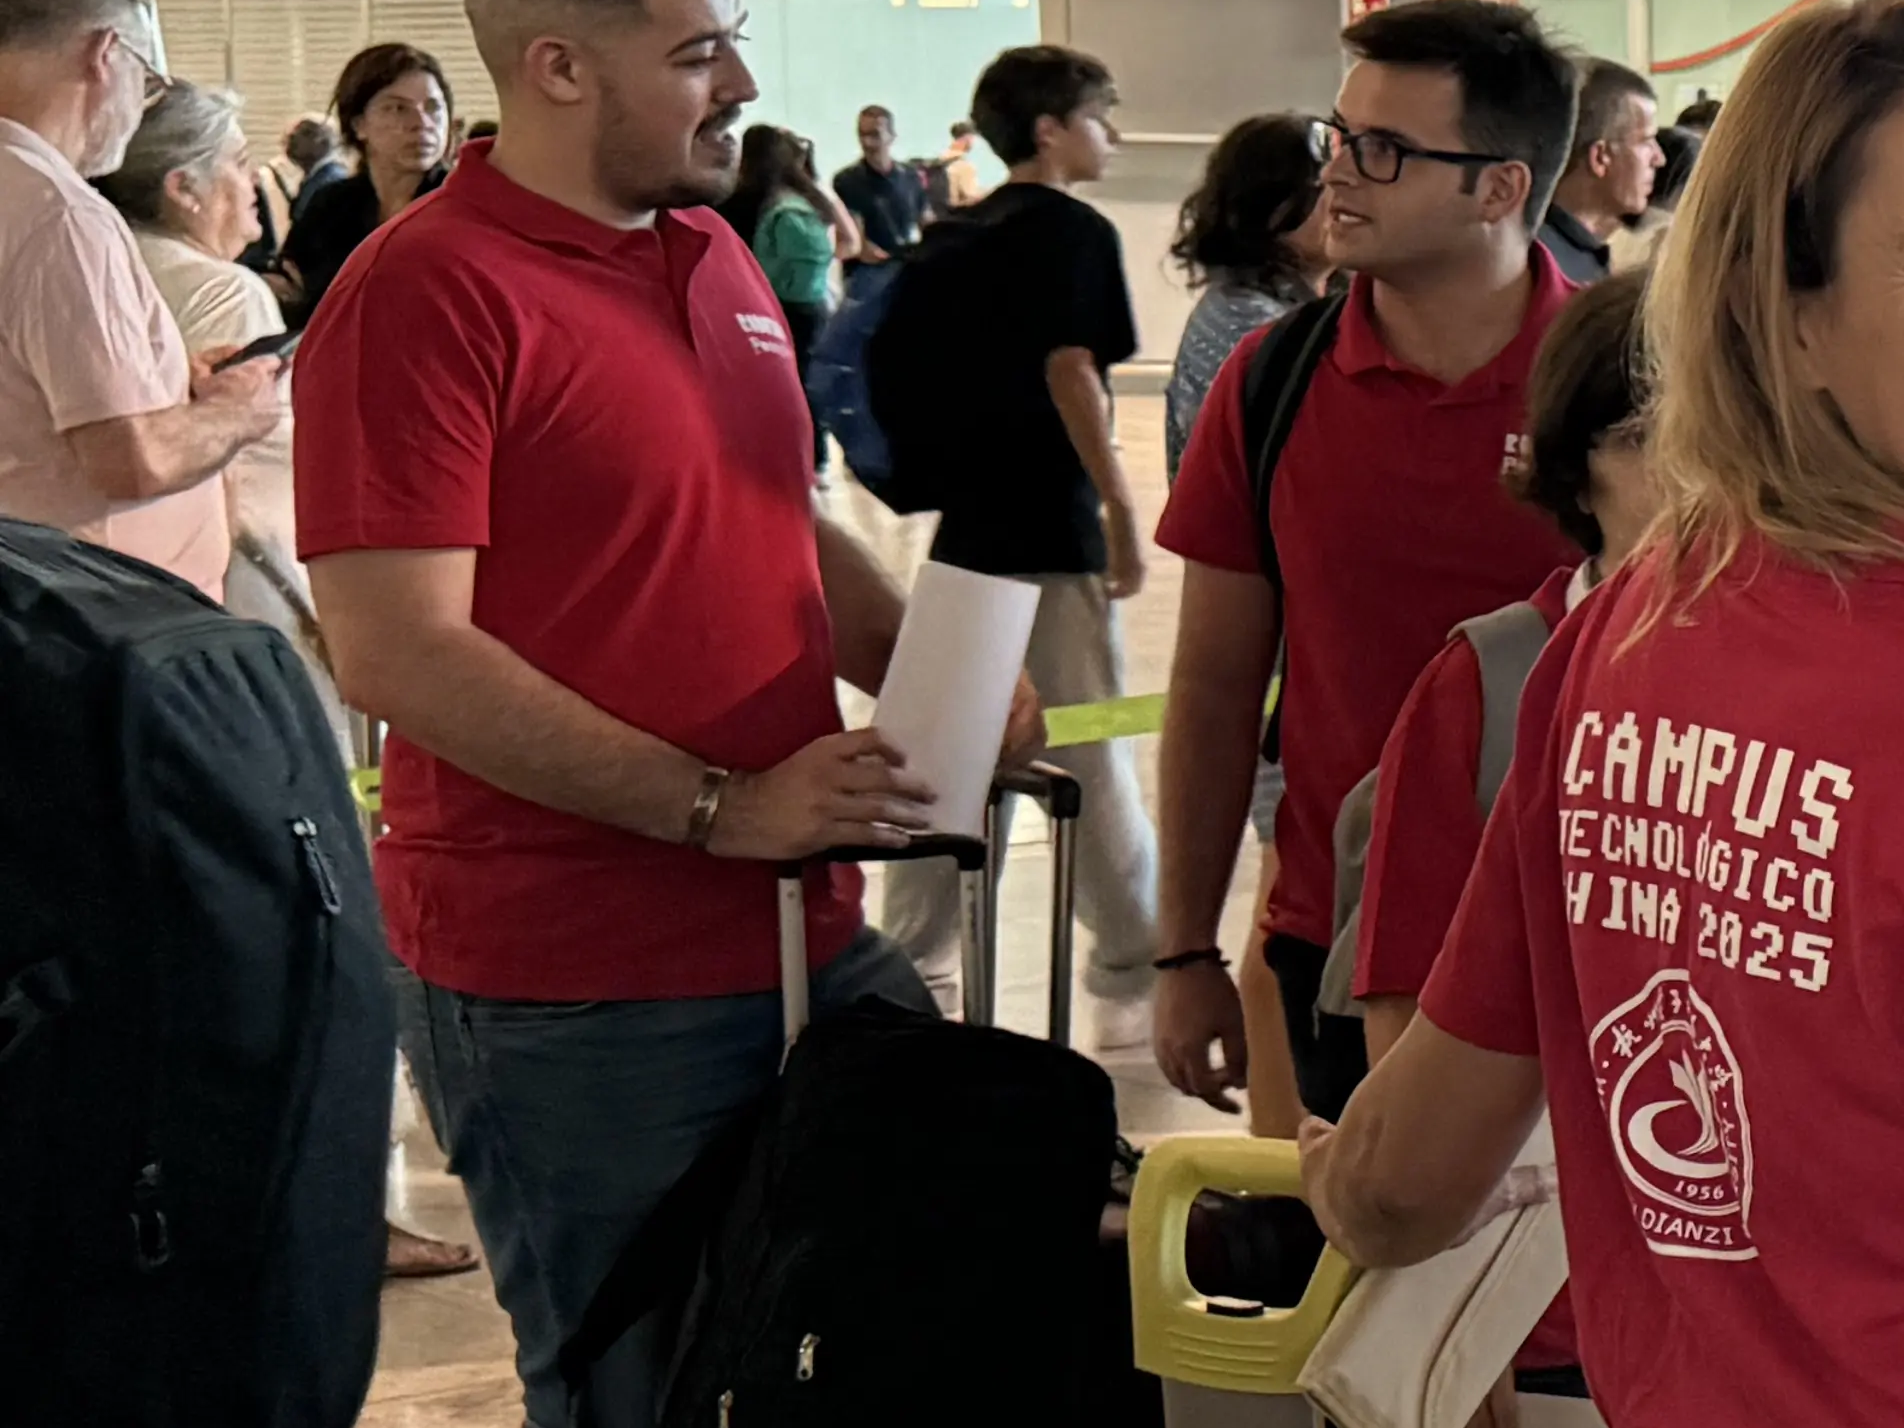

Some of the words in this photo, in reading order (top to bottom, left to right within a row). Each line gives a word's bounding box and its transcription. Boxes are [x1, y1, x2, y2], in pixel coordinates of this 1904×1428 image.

[1563, 711, 1854, 860] CAMPUS
[1566, 871, 1682, 945] HINA
[1697, 902, 1833, 992] 2025
[1641, 1207, 1735, 1246] DIANZI
[1674, 1179, 1725, 1201] 1956
